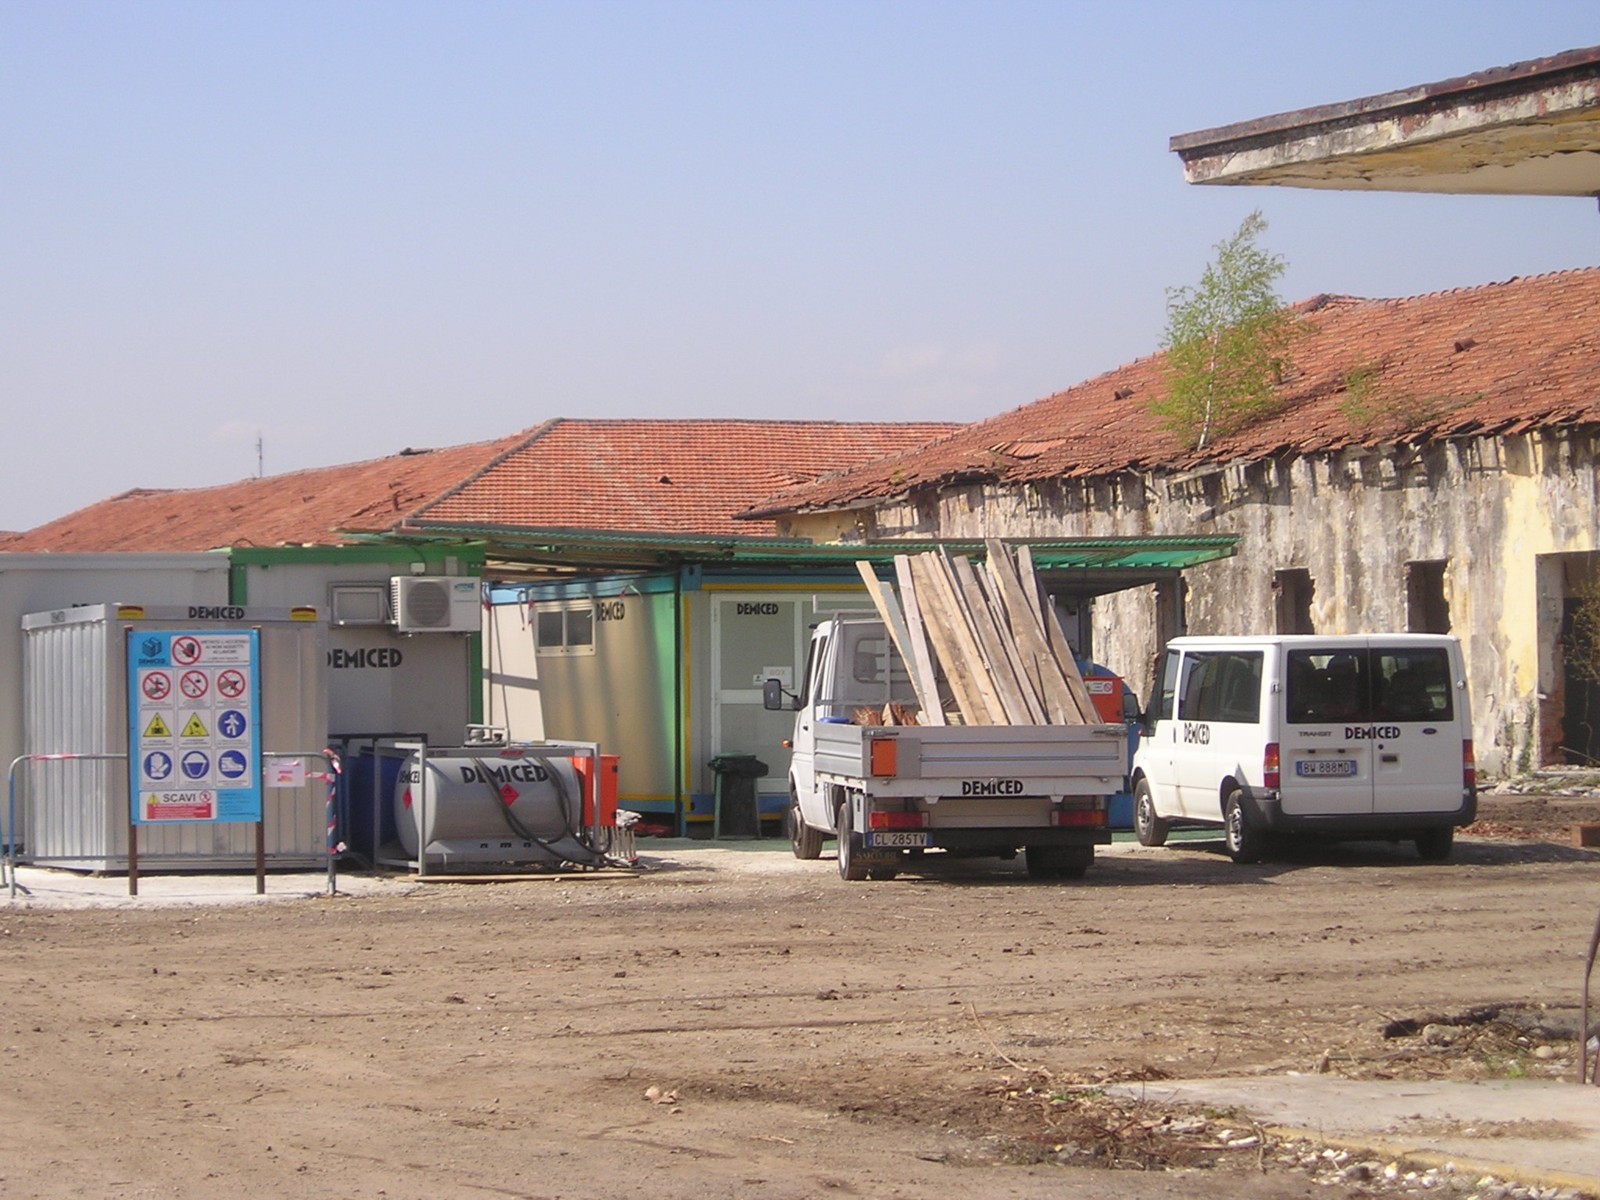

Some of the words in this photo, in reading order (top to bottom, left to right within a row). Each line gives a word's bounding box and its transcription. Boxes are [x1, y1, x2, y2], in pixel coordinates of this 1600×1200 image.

[188, 606, 245, 619] DEMICED
[737, 603, 779, 615] DEMICED
[1345, 726, 1401, 740] DEMICED
[962, 780, 1024, 795] DEMICED
[163, 793, 196, 803] SCAVI
[874, 834, 887, 845] CL
[892, 834, 926, 845] 285TV
